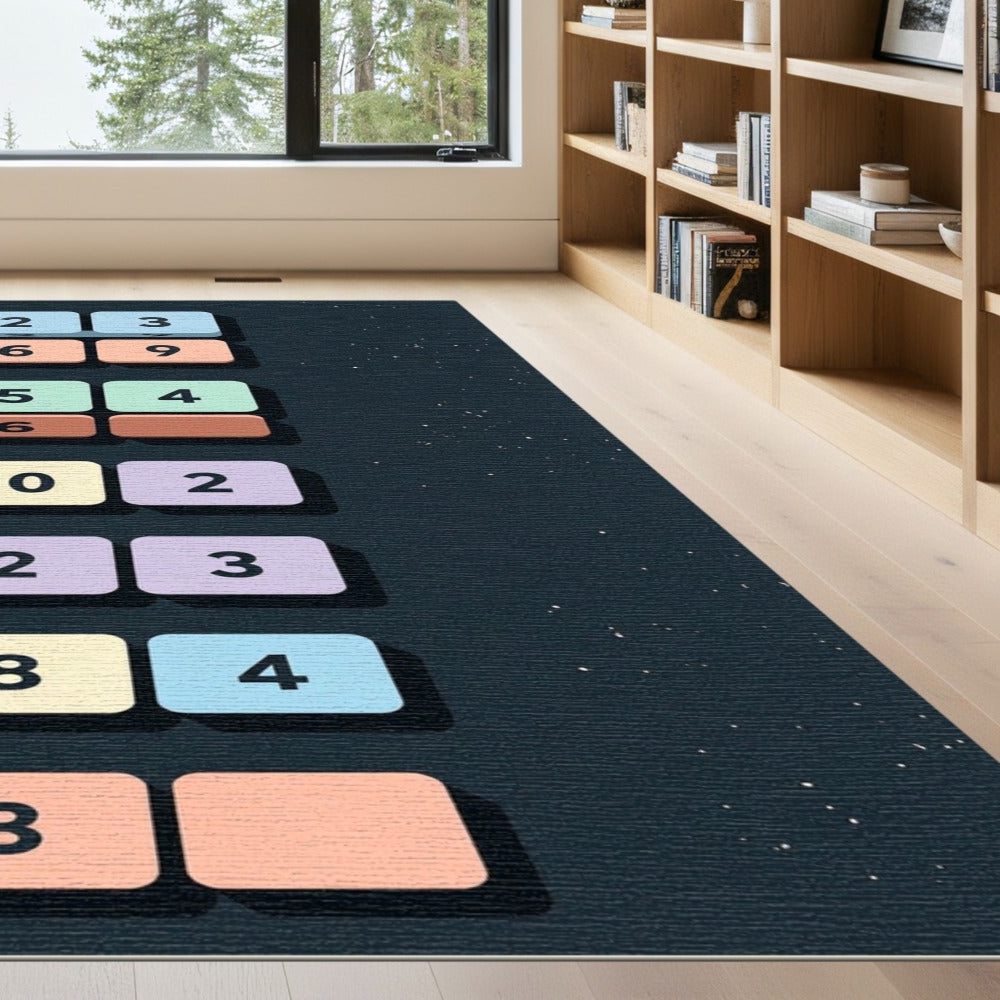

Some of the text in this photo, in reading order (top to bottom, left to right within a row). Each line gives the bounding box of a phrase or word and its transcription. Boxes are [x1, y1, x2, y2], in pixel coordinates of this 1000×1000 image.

[0, 316, 33, 328] 2
[138, 316, 172, 328] 3
[145, 344, 181, 357] 9
[157, 388, 202, 404] 4
[183, 472, 234, 493] 2
[207, 550, 264, 578] 3
[238, 654, 309, 691] 4
